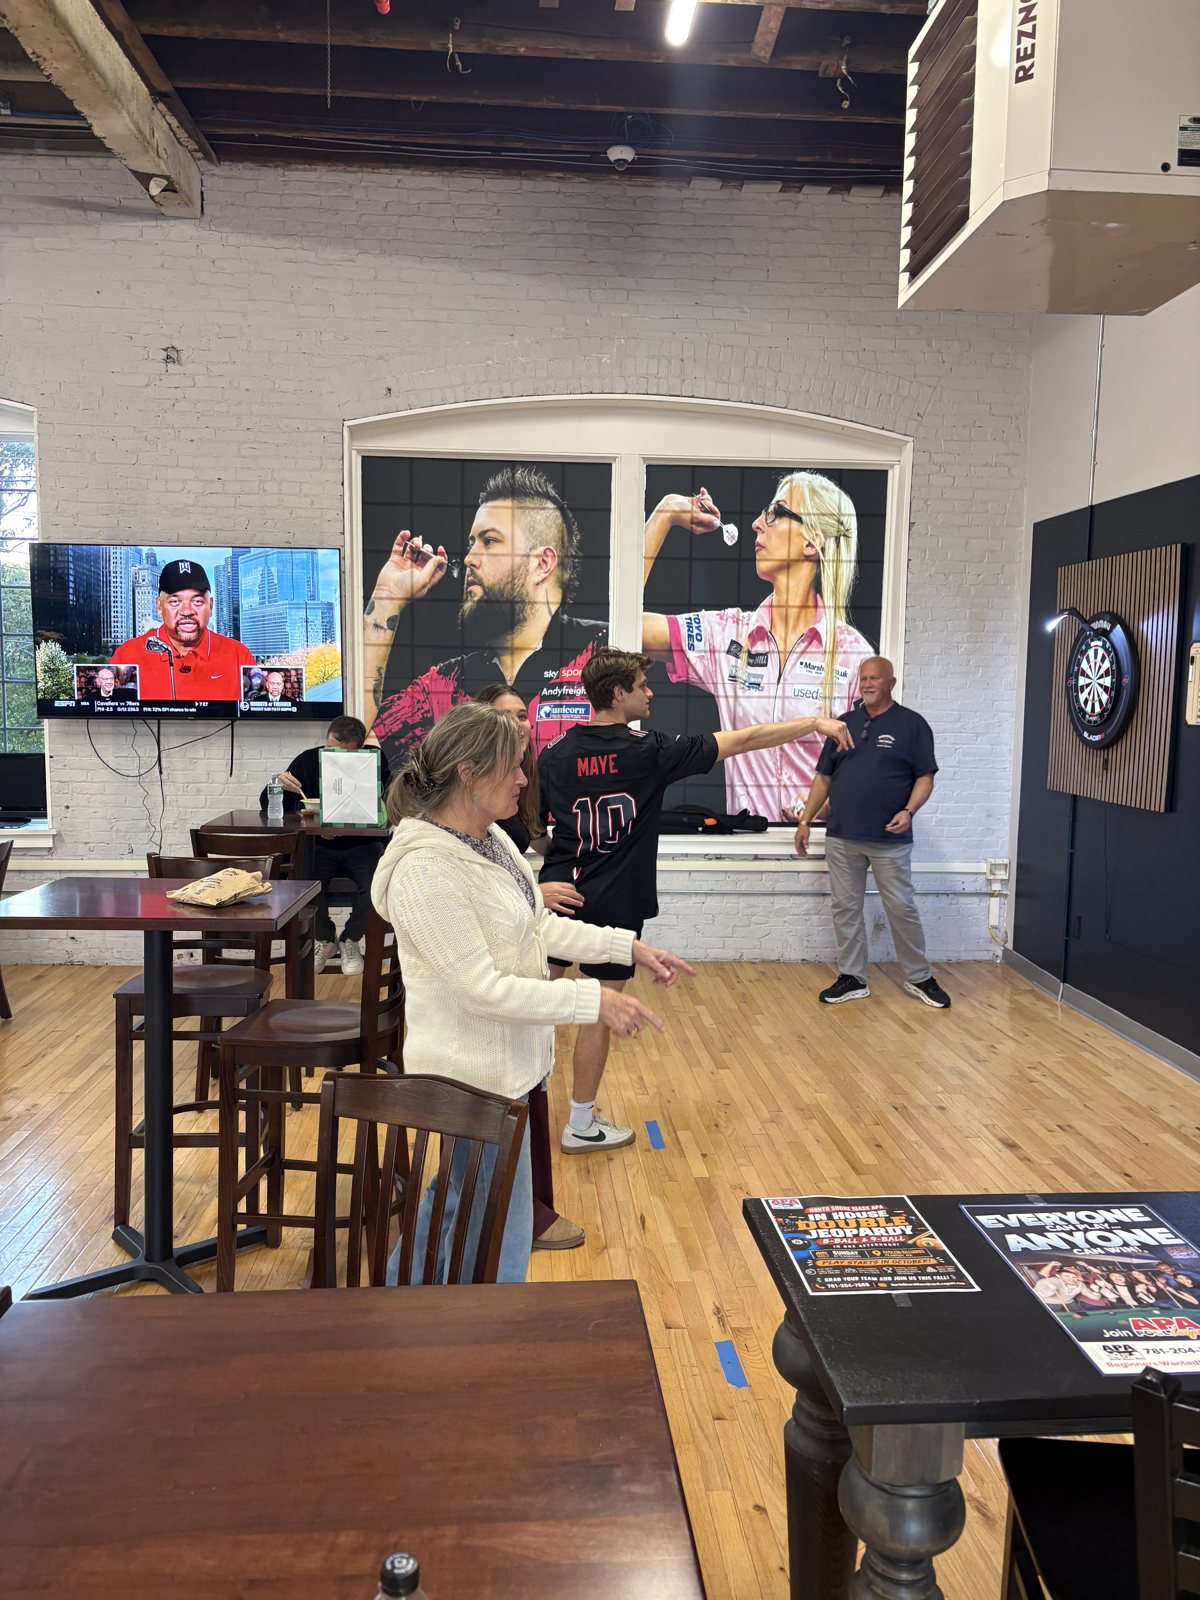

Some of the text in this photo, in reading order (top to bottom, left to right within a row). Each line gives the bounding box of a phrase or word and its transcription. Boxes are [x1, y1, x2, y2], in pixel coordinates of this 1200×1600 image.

[1014, 0, 1038, 84] REZN
[684, 616, 695, 652] TIRES
[692, 613, 703, 643] TOYO
[543, 668, 582, 679] sky spor
[541, 685, 587, 697] Andyfreigh
[552, 704, 587, 715] unicorn
[577, 753, 619, 777] MAYE
[571, 792, 638, 858] 10
[807, 1209, 890, 1221] IN HOUSE
[975, 1207, 1152, 1229] EVERYONE
[795, 1215, 910, 1231] DOUBLE
[1045, 1222, 1122, 1232] CAN PLAY...
[805, 1225, 914, 1239] JEOPARDY
[822, 1237, 860, 1245] 8-BALL
[870, 1235, 907, 1243] 9-BALL
[1004, 1227, 1186, 1252] ANYONE
[1072, 1245, 1144, 1256] CAN WIN!
[1128, 1317, 1200, 1332] APA
[1103, 1328, 1134, 1338] Join
[1102, 1344, 1136, 1354] APA
[1106, 1361, 1158, 1369] Beginners
